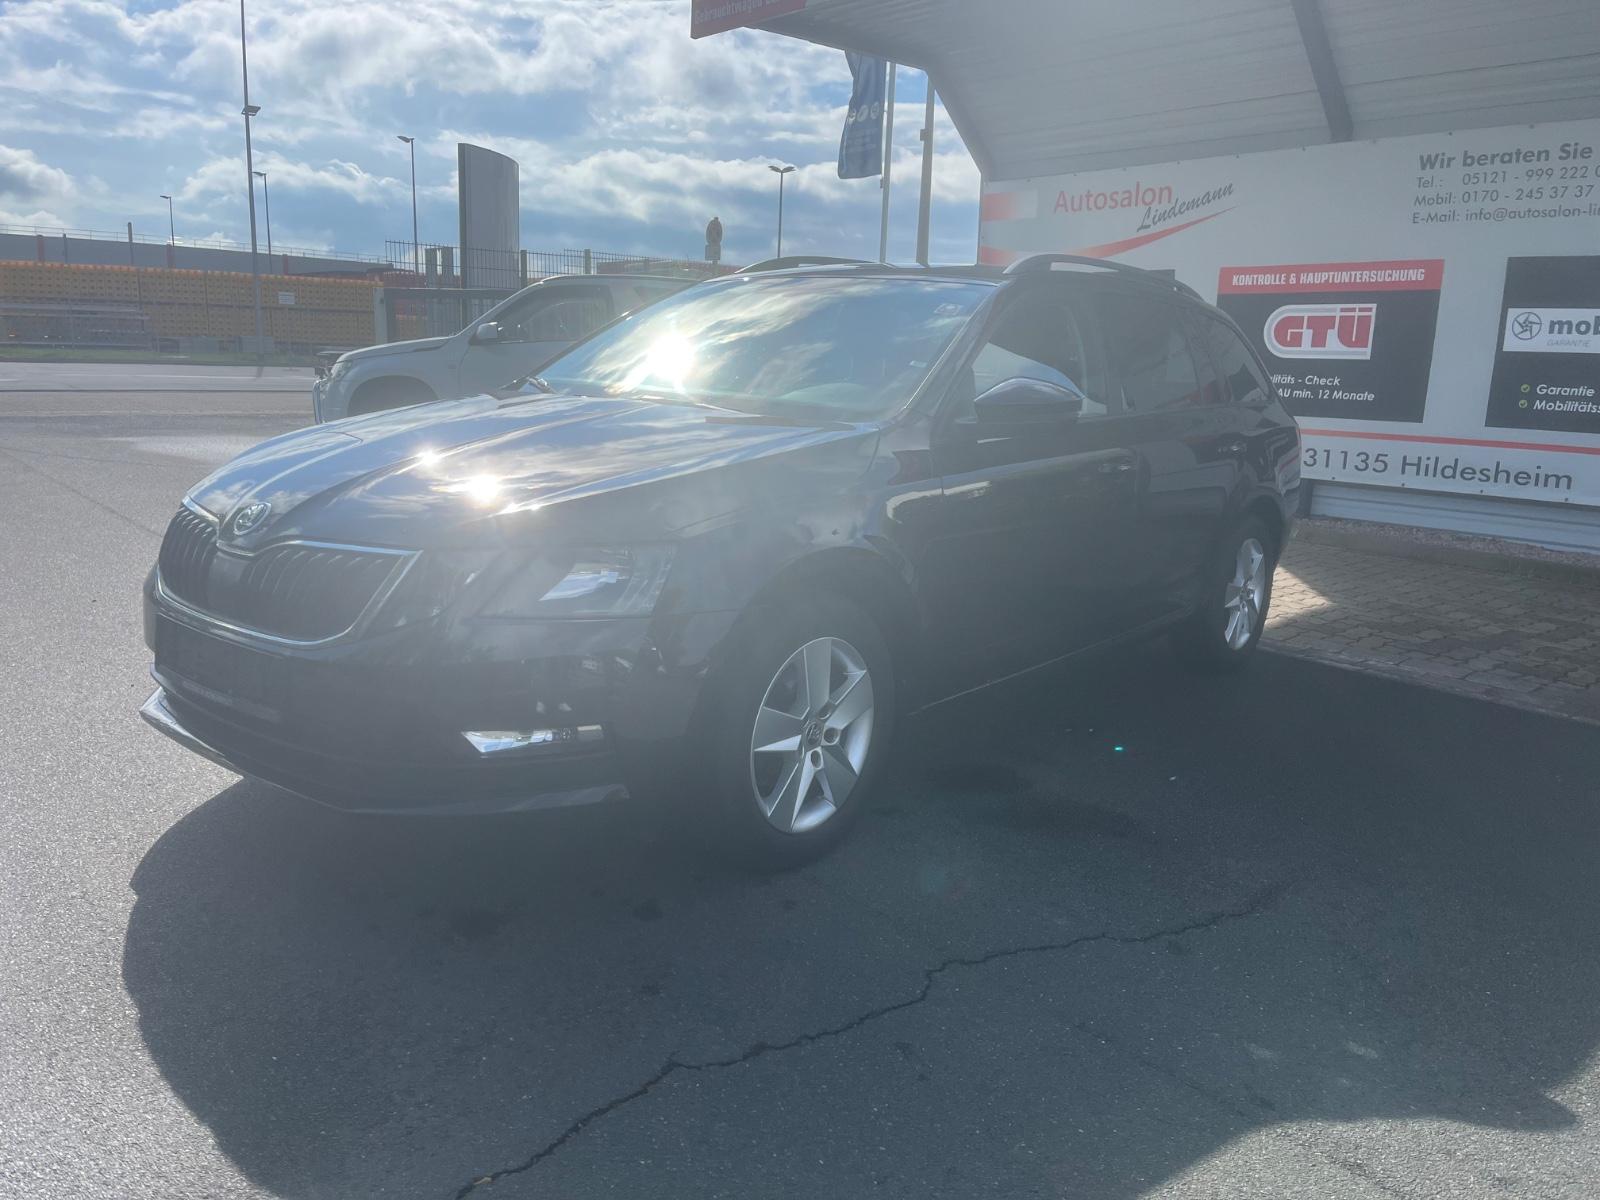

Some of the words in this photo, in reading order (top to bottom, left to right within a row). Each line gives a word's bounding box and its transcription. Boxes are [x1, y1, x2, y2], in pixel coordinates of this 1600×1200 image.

[1418, 152, 1456, 171] Wir
[1462, 148, 1550, 167] beraten
[1558, 142, 1593, 161] Sie
[1416, 175, 1443, 189] Tel.:
[1462, 171, 1507, 185] 05121
[1526, 168, 1554, 182] 999
[1559, 166, 1589, 179] 222
[1053, 181, 1173, 214] Autosalon
[1414, 191, 1456, 207] Mobil:
[1462, 189, 1499, 203] 0170
[1515, 187, 1544, 201] 245
[1549, 185, 1569, 199] 37
[1574, 184, 1595, 198] 37
[1136, 183, 1234, 233] Lindemann
[1412, 210, 1460, 224] E-Mail:
[1232, 273, 1287, 286] KONTROLLE
[1289, 272, 1297, 284] &
[1300, 268, 1426, 285] HAUPTUNTERSUCHUNG
[1273, 307, 1374, 349] GTÜ
[1304, 375, 1341, 386] Check
[1536, 384, 1595, 397] Garantie
[1293, 388, 1314, 399] min.
[1318, 389, 1330, 399] 12
[1332, 390, 1375, 401] Monate
[1303, 448, 1389, 473] 31135
[1400, 455, 1573, 490] Hildesheim
